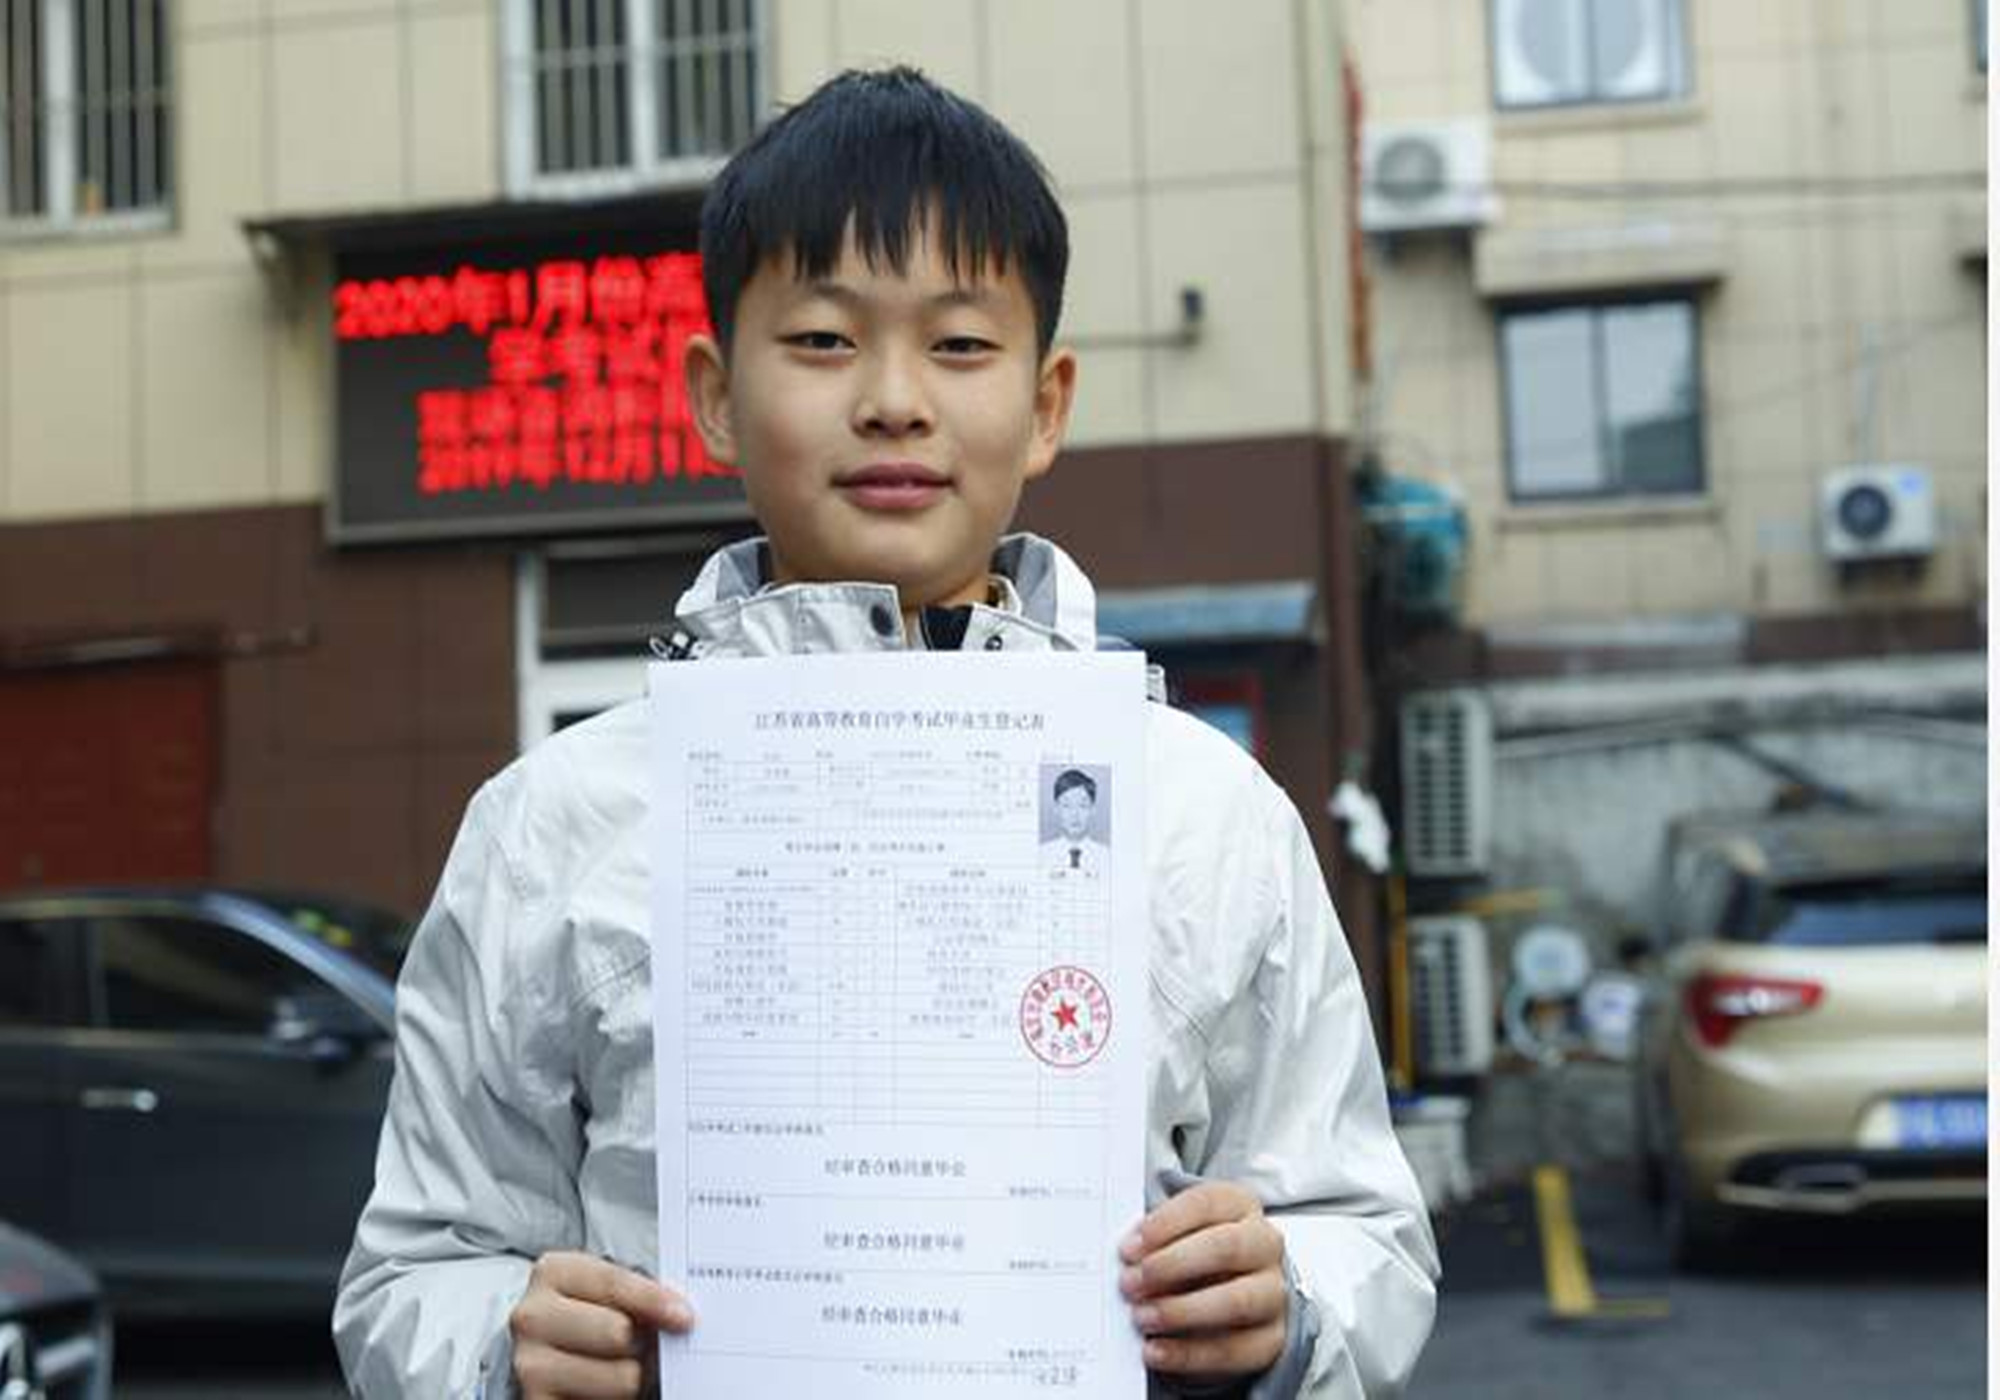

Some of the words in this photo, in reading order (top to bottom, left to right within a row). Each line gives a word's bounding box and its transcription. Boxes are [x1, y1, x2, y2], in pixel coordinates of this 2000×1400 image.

[755, 710, 1044, 730] 江苏省高等教育自学考试毕业生登记表
[824, 1158, 965, 1177] 经审查合格同意毕业
[824, 1232, 964, 1250] 经审查合格同意毕业
[821, 1306, 961, 1325] 经审查合格同意毕业
